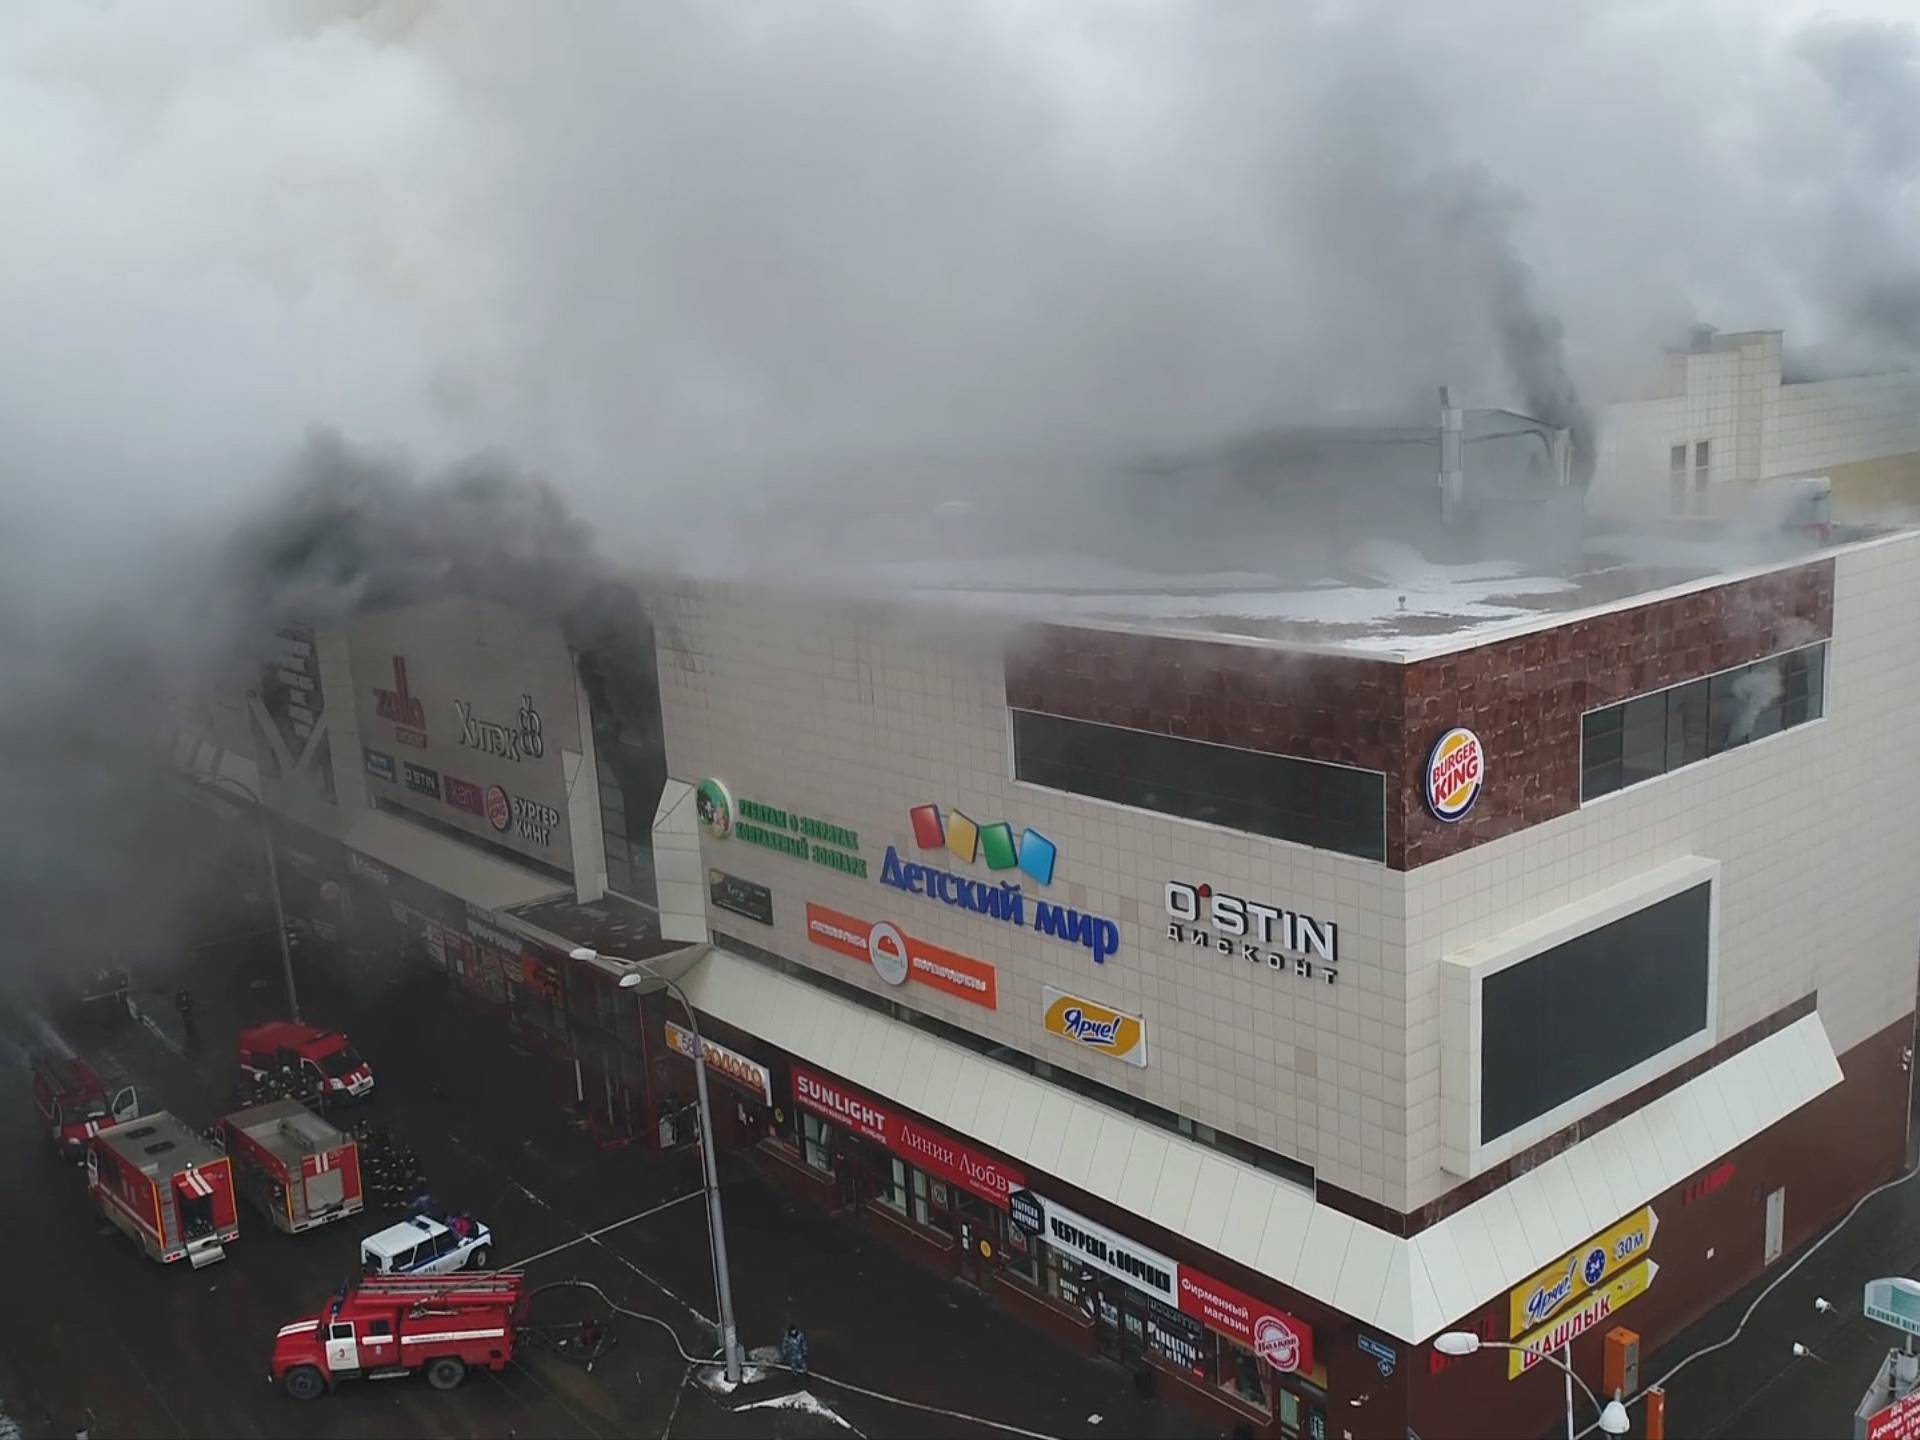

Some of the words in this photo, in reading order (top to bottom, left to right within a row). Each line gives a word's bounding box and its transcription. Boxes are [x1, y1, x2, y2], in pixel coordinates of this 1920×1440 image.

[1433, 740, 1477, 784] BURGER
[1434, 756, 1478, 807] KING
[513, 795, 560, 828] БУРГЕР
[513, 817, 550, 847] КИНГ
[879, 845, 1025, 926] Детский
[1034, 901, 1120, 964] мир
[1165, 881, 1338, 962] O'STIN
[1167, 923, 1338, 985] ДИСКОНТ
[1064, 1008, 1121, 1042] Ярче!
[797, 1075, 886, 1131] SUNLIGHT
[901, 1124, 954, 1166] Линии
[1051, 1216, 1107, 1262] ЧЕБУРЕКИ
[1116, 1249, 1171, 1294] ПОНЧИКИ
[1181, 1278, 1249, 1320] Фирменный
[1526, 1256, 1578, 1326] Ярче!
[1204, 1305, 1250, 1335] магазин
[1523, 1295, 1612, 1369] ШАШЛЫК
